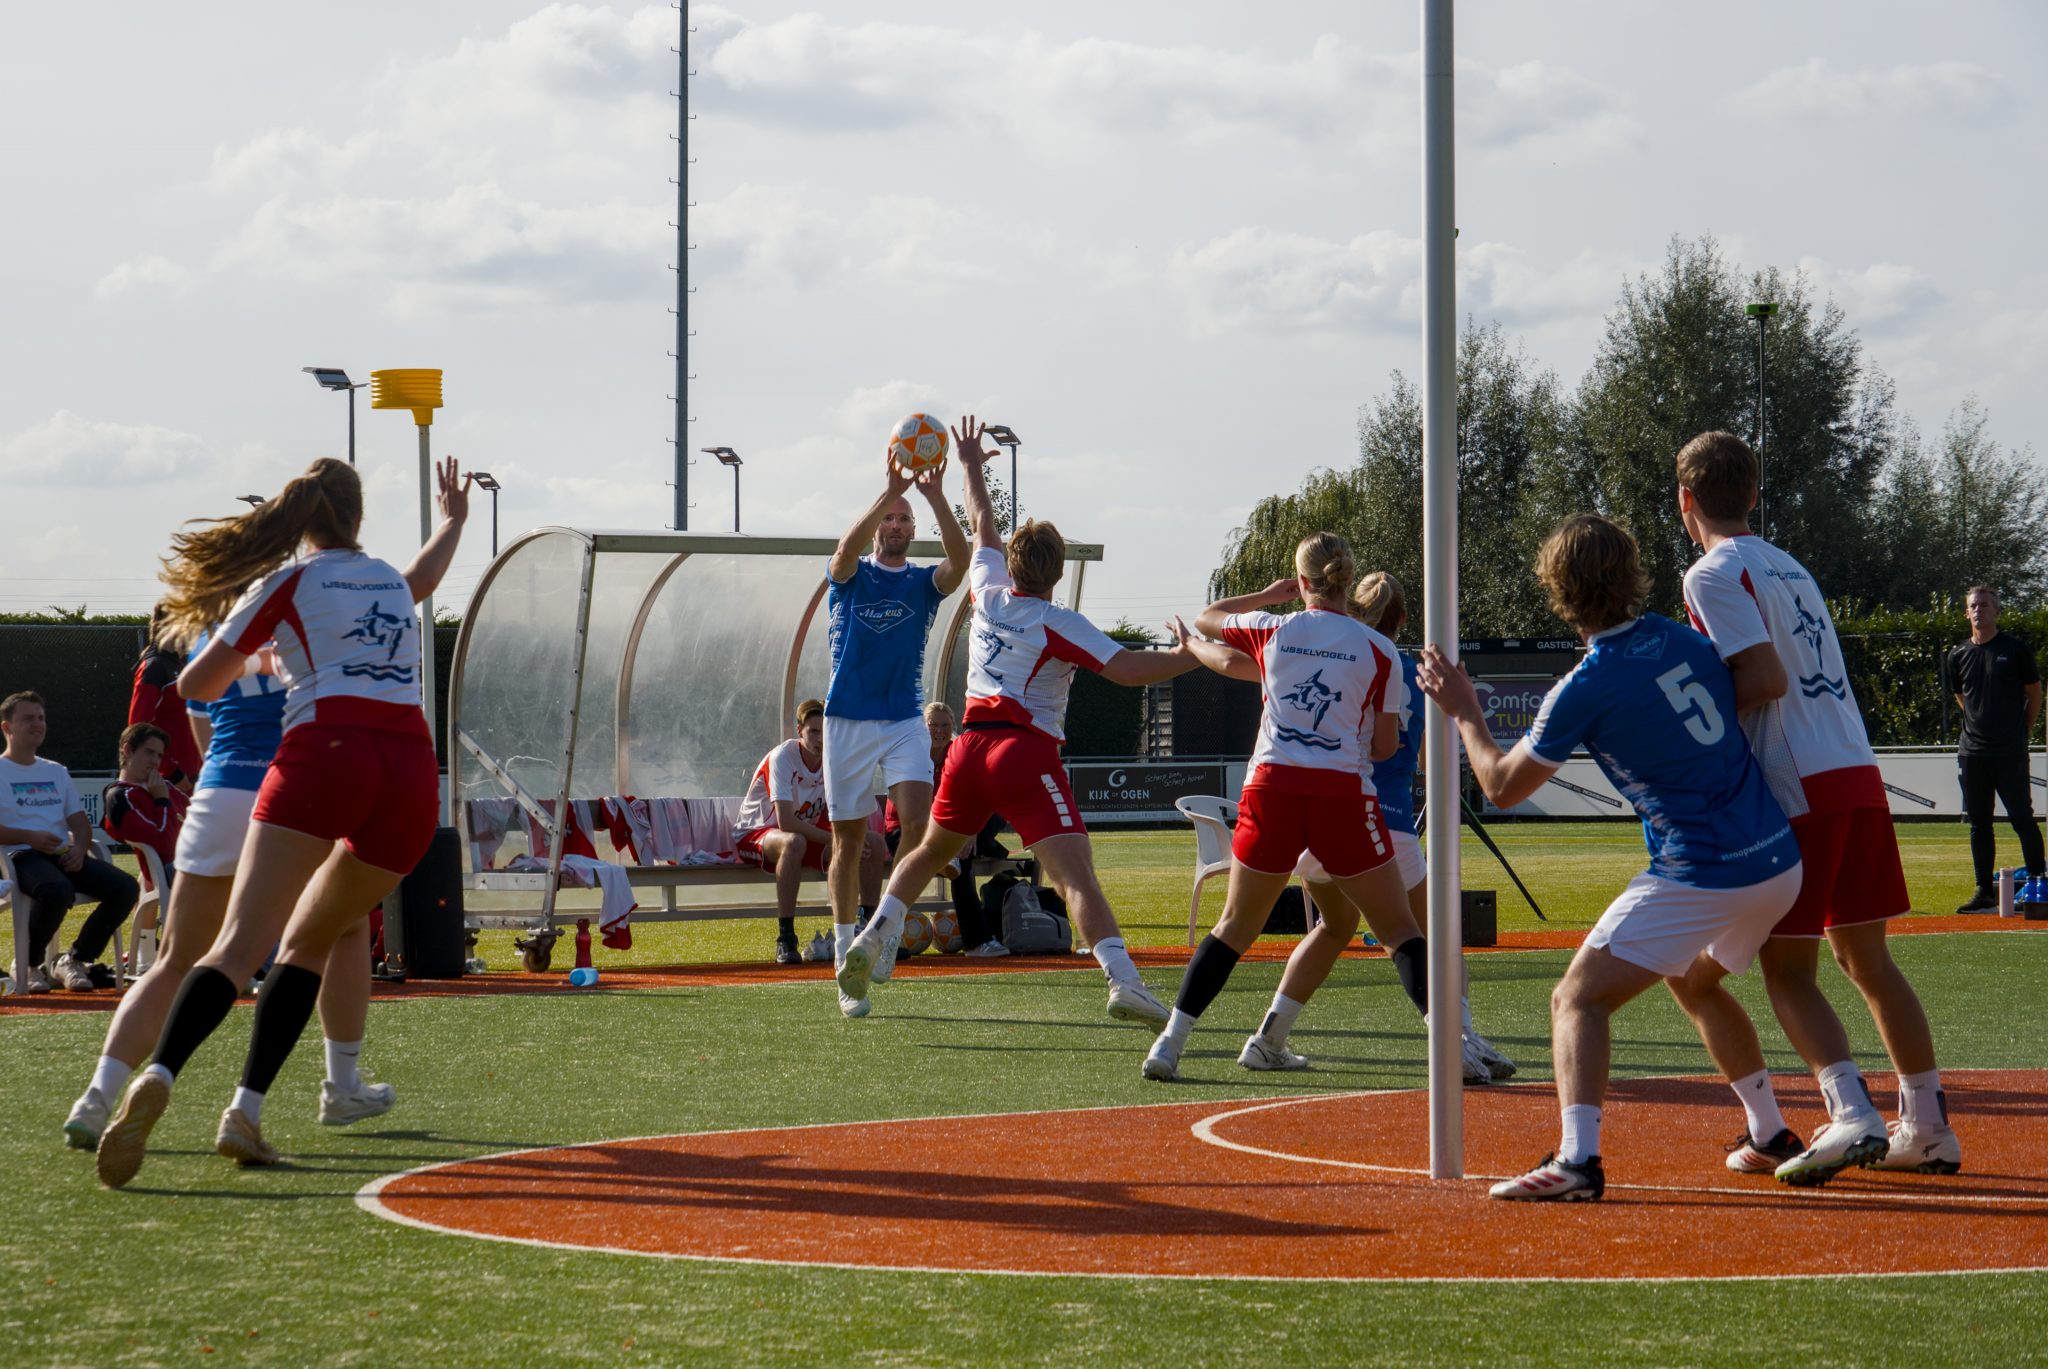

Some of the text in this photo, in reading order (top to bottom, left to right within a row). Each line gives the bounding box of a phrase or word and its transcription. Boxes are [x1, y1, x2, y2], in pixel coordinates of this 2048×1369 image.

[1459, 642, 1481, 650] HUIS
[1537, 641, 1574, 649] GASTEN
[1280, 645, 1357, 662] IJSSELVOGELS
[1472, 682, 1542, 719] Comfo
[1655, 661, 1725, 746] 5
[1089, 790, 1110, 800] KIJK
[1121, 789, 1150, 799] OGEN
